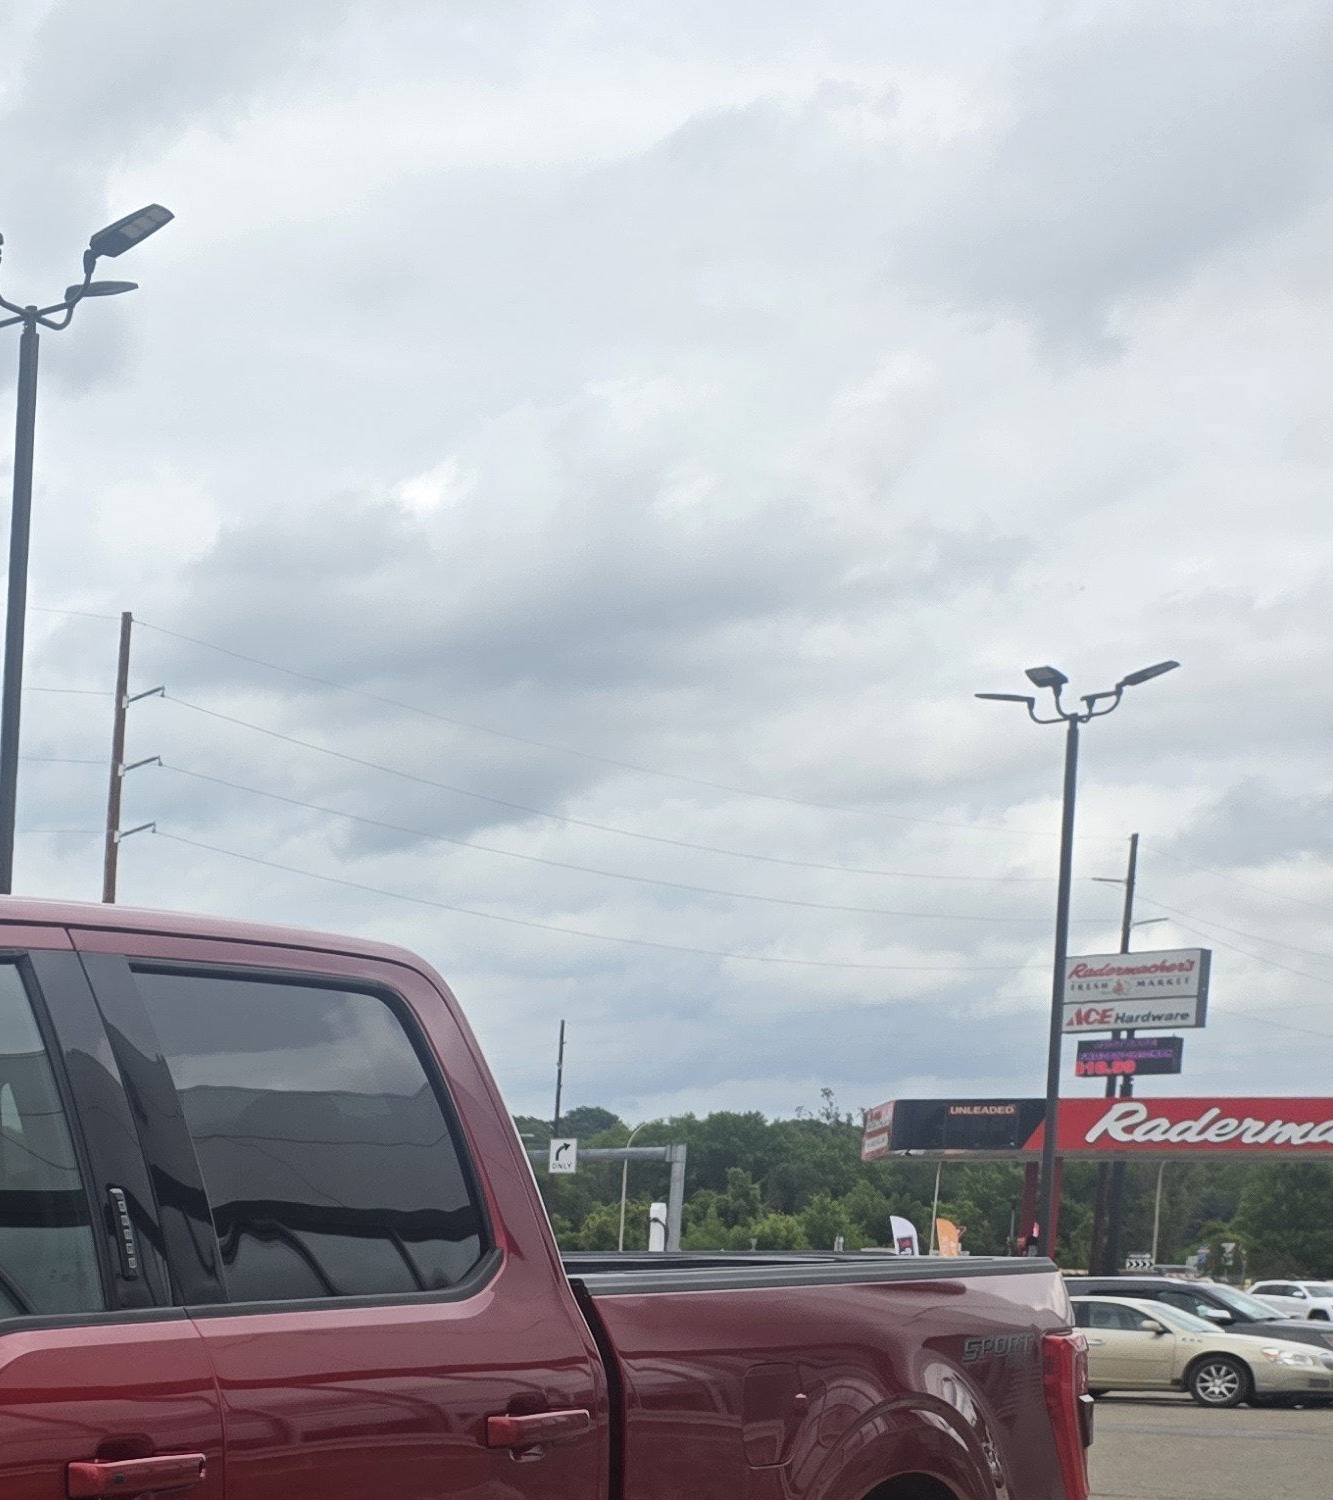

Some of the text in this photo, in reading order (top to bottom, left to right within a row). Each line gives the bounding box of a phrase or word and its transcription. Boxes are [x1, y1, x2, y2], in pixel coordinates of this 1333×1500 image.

[1065, 1006, 1190, 1026] ACE Hardware
[949, 1105, 1016, 1115] UNLEADED
[551, 1160, 572, 1170] ONLY
